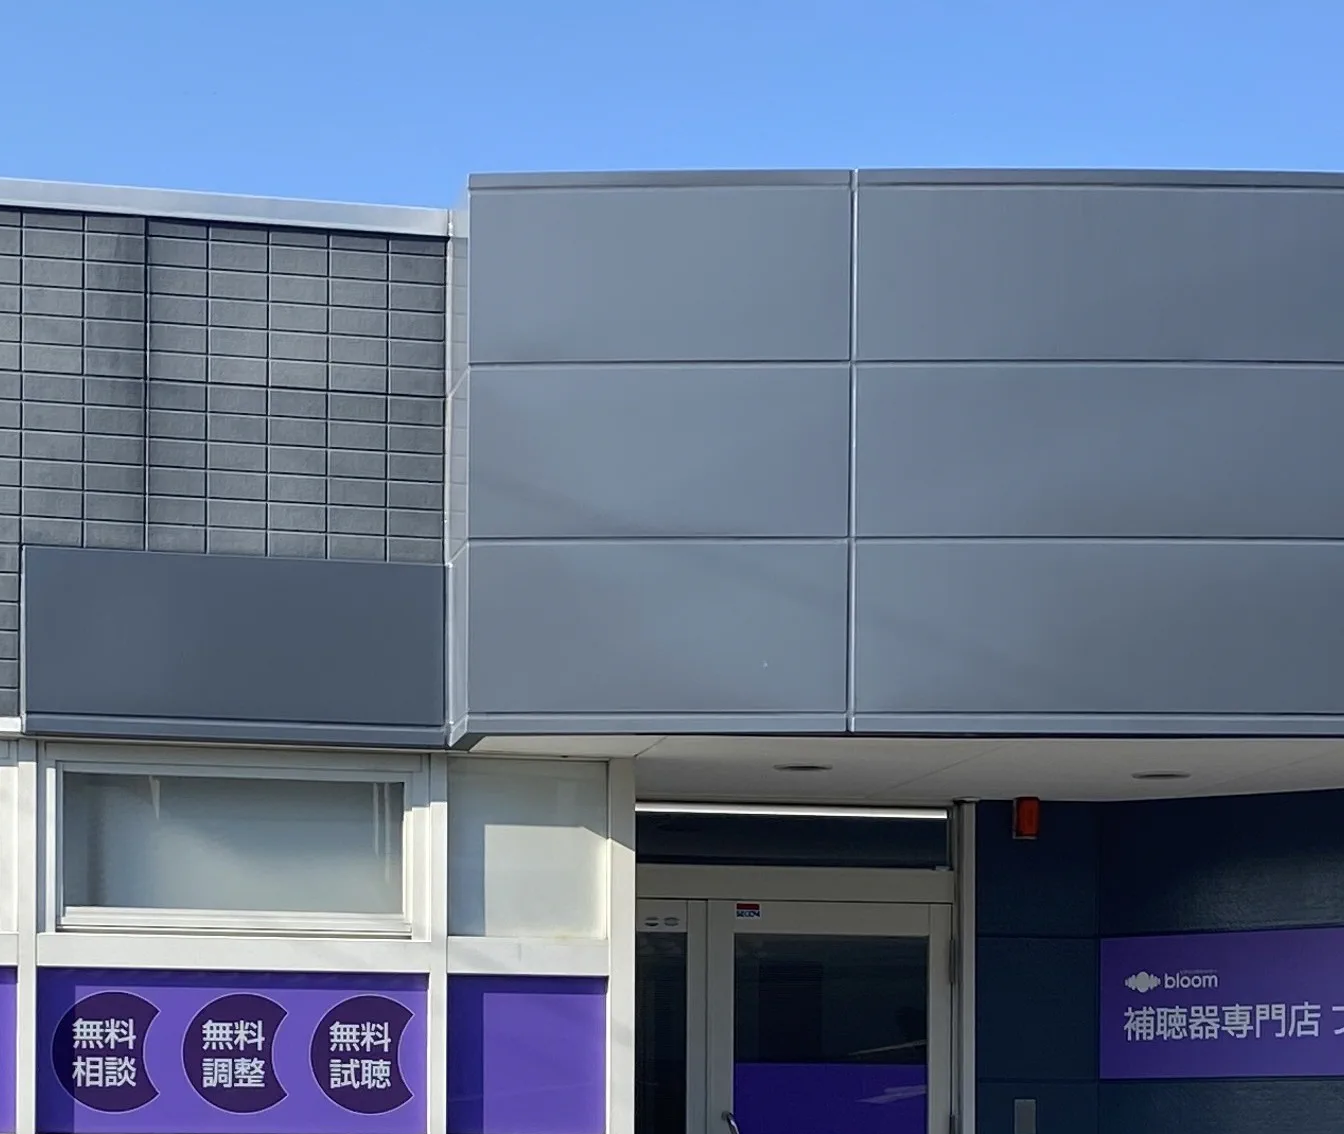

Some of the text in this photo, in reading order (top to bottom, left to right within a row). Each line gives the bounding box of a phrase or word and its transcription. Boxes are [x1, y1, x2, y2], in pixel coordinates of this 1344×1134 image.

[1164, 972, 1218, 989] bloom
[72, 1018, 136, 1050] 無料
[201, 1019, 266, 1052] 無料
[329, 1021, 392, 1053] 無料
[1123, 1001, 1321, 1042] 補聴器専門店
[72, 1055, 137, 1088] 相談
[201, 1057, 266, 1089] 調整
[329, 1058, 392, 1090] 試聴
